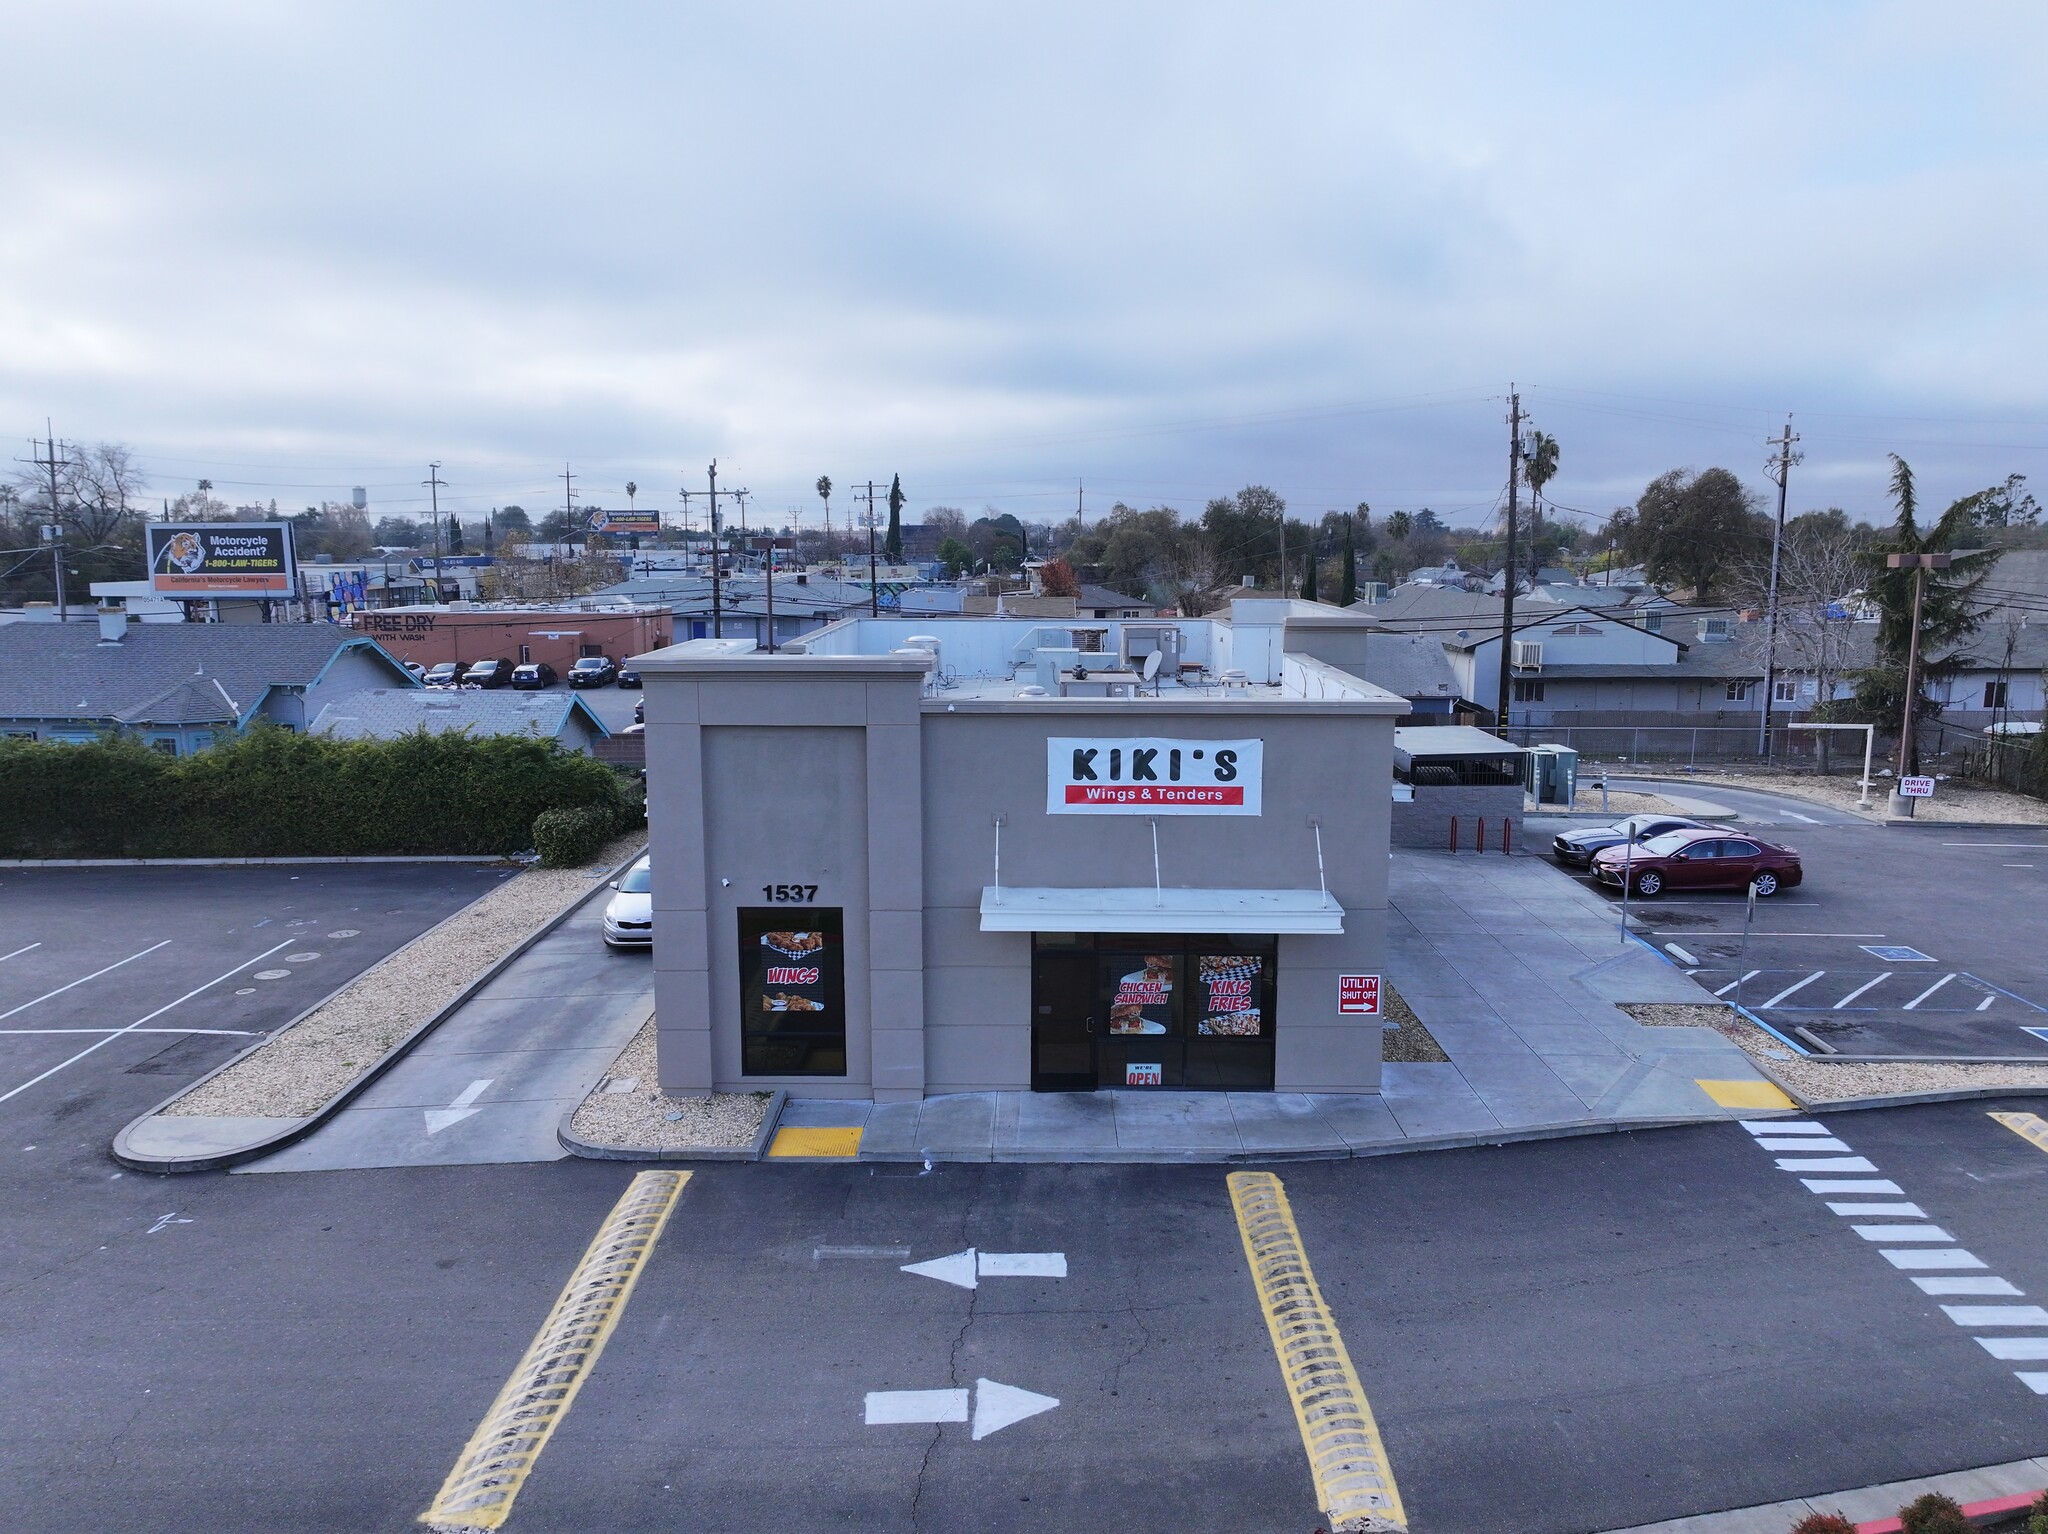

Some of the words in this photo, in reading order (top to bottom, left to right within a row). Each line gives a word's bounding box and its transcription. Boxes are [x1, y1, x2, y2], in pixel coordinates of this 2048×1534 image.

[210, 535, 268, 547] Motorcycle
[214, 547, 267, 556] Accident?
[205, 559, 278, 567] 1-800-LAW-TIGERS
[207, 576, 242, 584] Motorcycle
[243, 576, 269, 584] Lawyers
[363, 615, 402, 631] FREE
[405, 615, 436, 631] DRY
[1072, 748, 1238, 782] KIKI'S
[1904, 779, 1931, 787] DRIVE
[1086, 788, 1136, 802] Wings
[1141, 788, 1152, 800] &
[1156, 788, 1223, 801] Tenders
[762, 885, 818, 902] 1537
[767, 967, 819, 984] WINGS
[1119, 982, 1163, 993] CHICKEN
[1209, 980, 1252, 995] KIKIS
[1342, 978, 1377, 988] UTILITY
[1114, 992, 1168, 1005] SANDWICH
[1341, 990, 1361, 1000] SHUT
[1362, 990, 1377, 1000] OFF
[1208, 995, 1252, 1012] FRIES
[1128, 1072, 1160, 1085] OPEN
